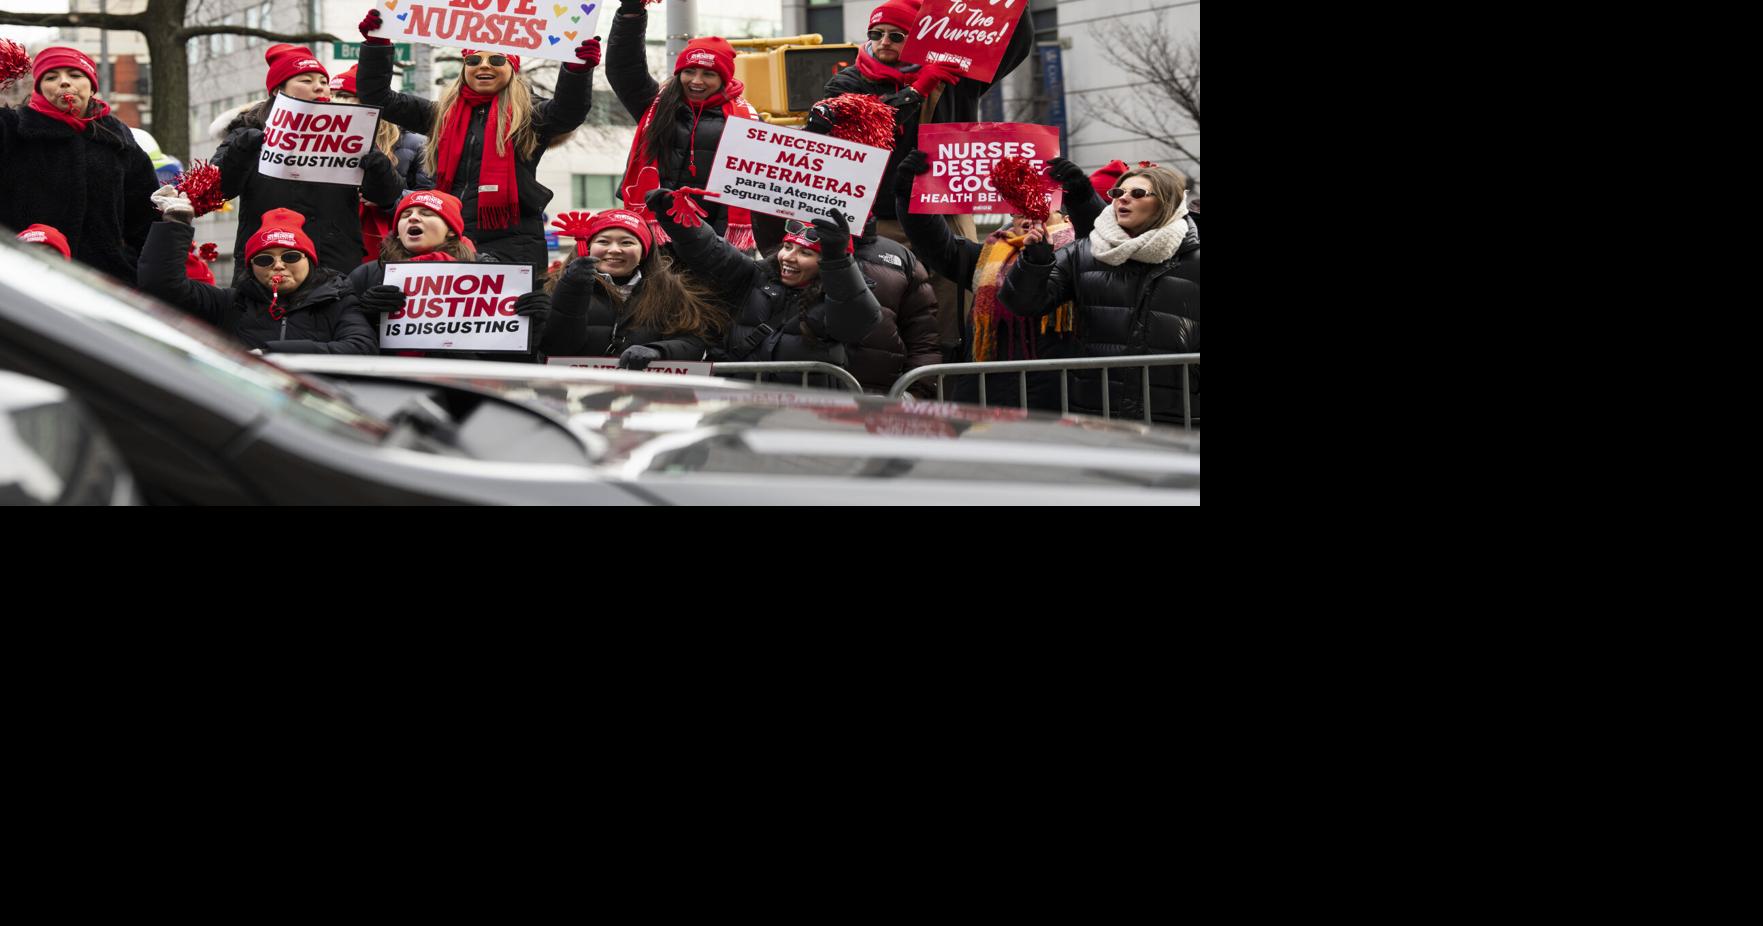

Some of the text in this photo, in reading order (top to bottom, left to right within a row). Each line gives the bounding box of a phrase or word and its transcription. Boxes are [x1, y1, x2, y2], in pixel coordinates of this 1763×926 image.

[403, 4, 547, 50] NURSES
[965, 8, 994, 27] The
[916, 15, 1010, 45] Nurses!
[272, 108, 353, 133] UNION
[747, 128, 867, 163] SE NECESITAN
[938, 142, 1036, 159] NURSES
[261, 150, 357, 169] DISGUSTING
[775, 151, 824, 172] MÁS
[725, 156, 866, 199] ENFERMERAS
[723, 185, 770, 204] Segura
[773, 196, 795, 209] del
[798, 201, 855, 222] Paciete
[735, 177, 847, 208] para la Atención
[920, 193, 972, 203] HEALTH
[403, 274, 505, 297] UNION
[385, 320, 519, 336] IS DISGUSTING
